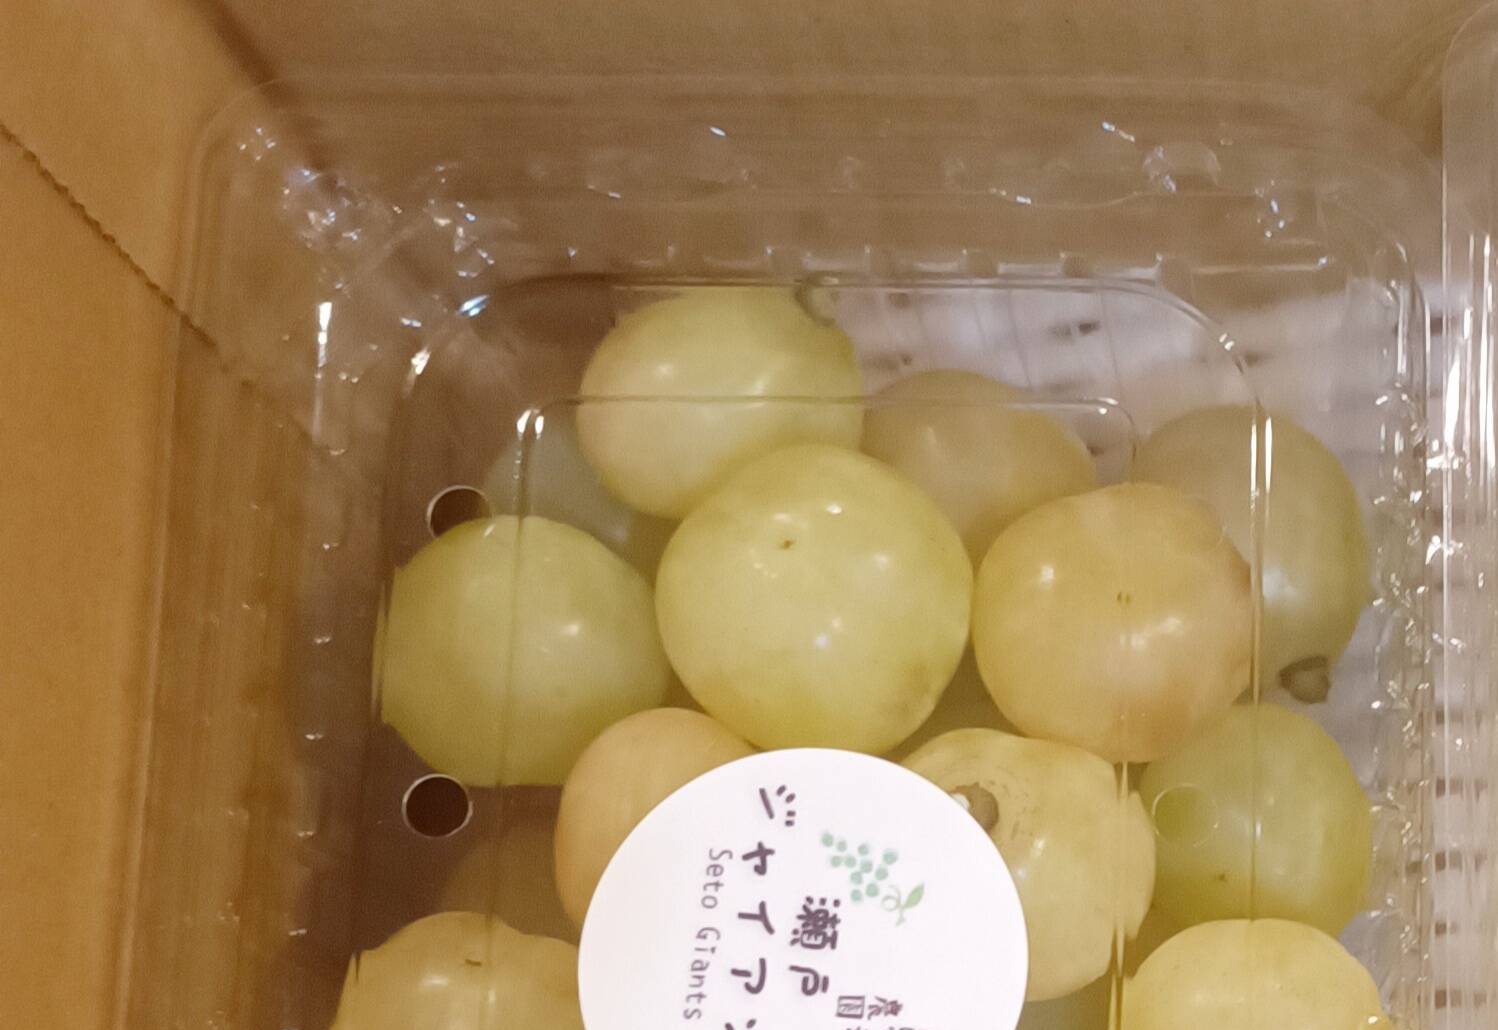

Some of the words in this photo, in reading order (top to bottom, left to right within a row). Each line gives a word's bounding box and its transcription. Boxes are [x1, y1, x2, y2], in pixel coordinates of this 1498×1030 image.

[700, 848, 733, 910] Seto
[682, 925, 721, 1020] Giants
[788, 895, 842, 997] 瀬戸
